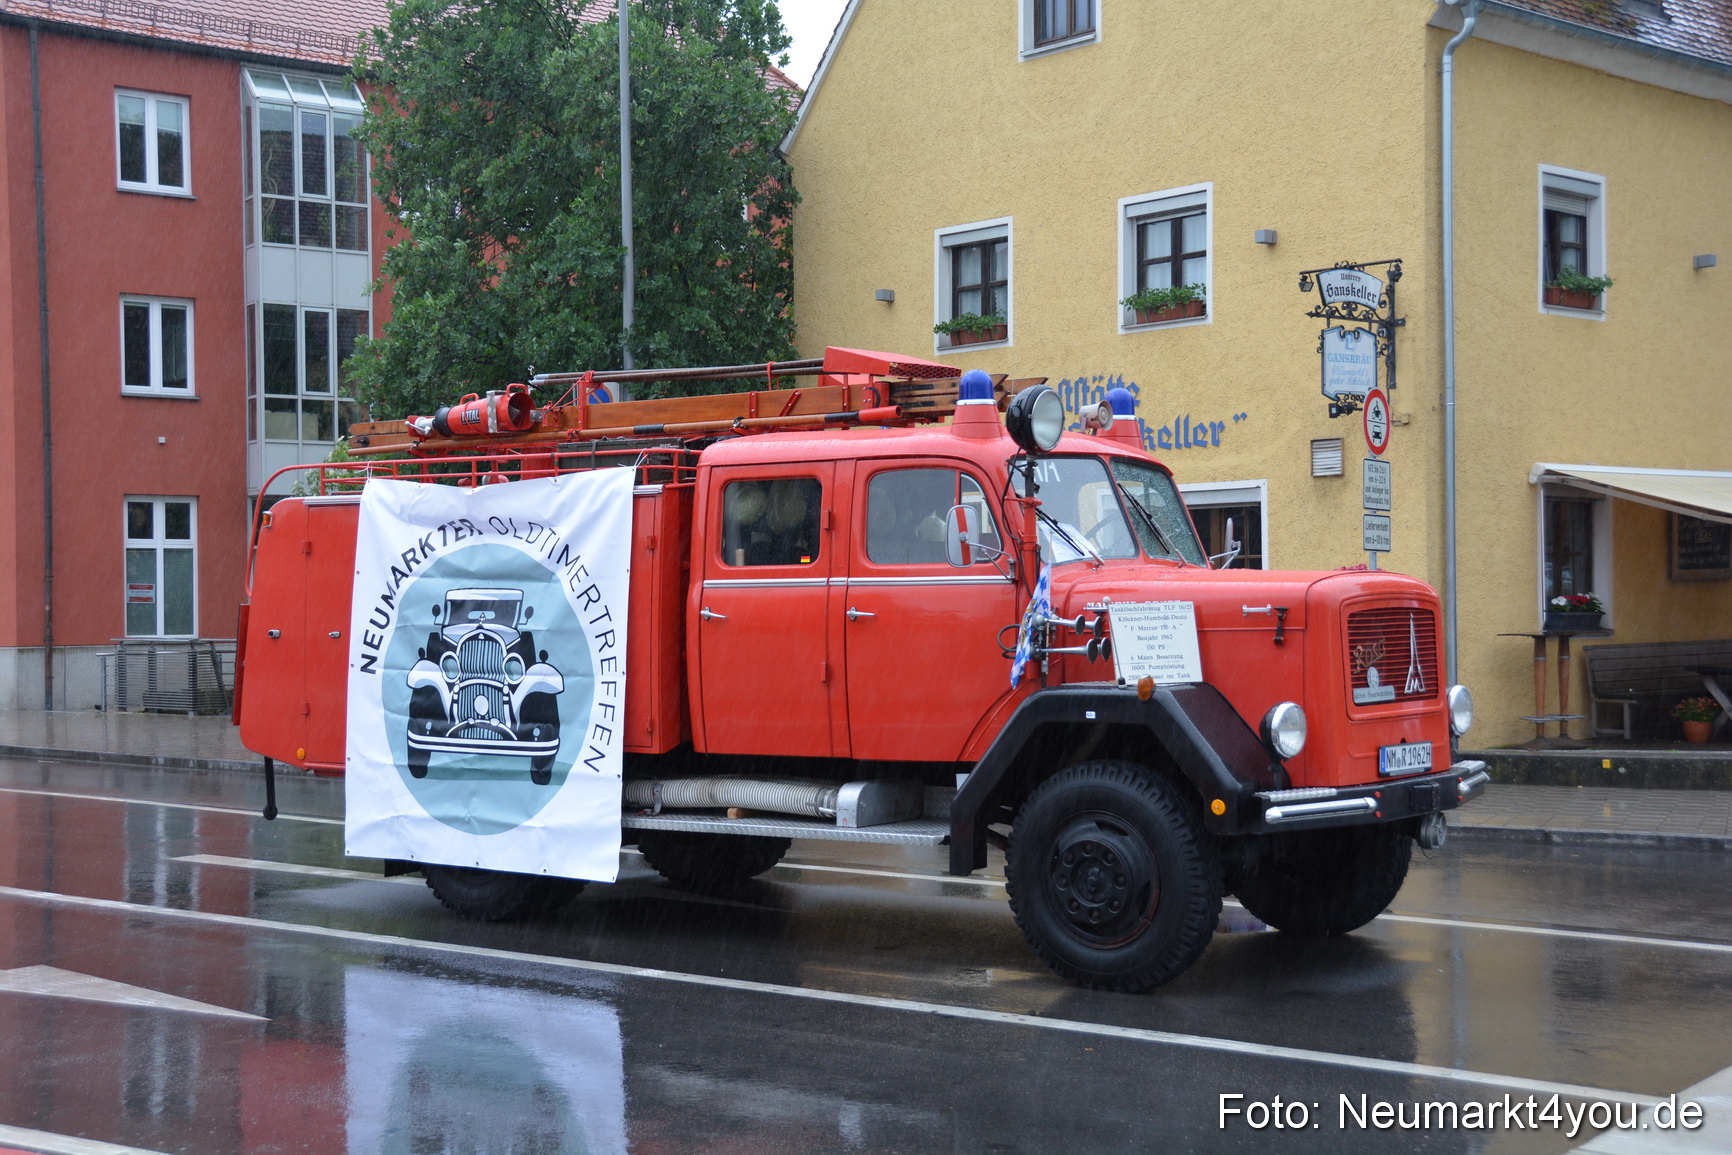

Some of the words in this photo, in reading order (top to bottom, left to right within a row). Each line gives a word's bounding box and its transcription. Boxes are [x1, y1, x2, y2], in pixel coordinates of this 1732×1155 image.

[1326, 283, 1377, 303] Ganskeller
[1328, 352, 1372, 364] GANSBRÄU
[360, 517, 483, 675] NEUMARKTER
[488, 515, 618, 773] OLDTIMERTREFFEN
